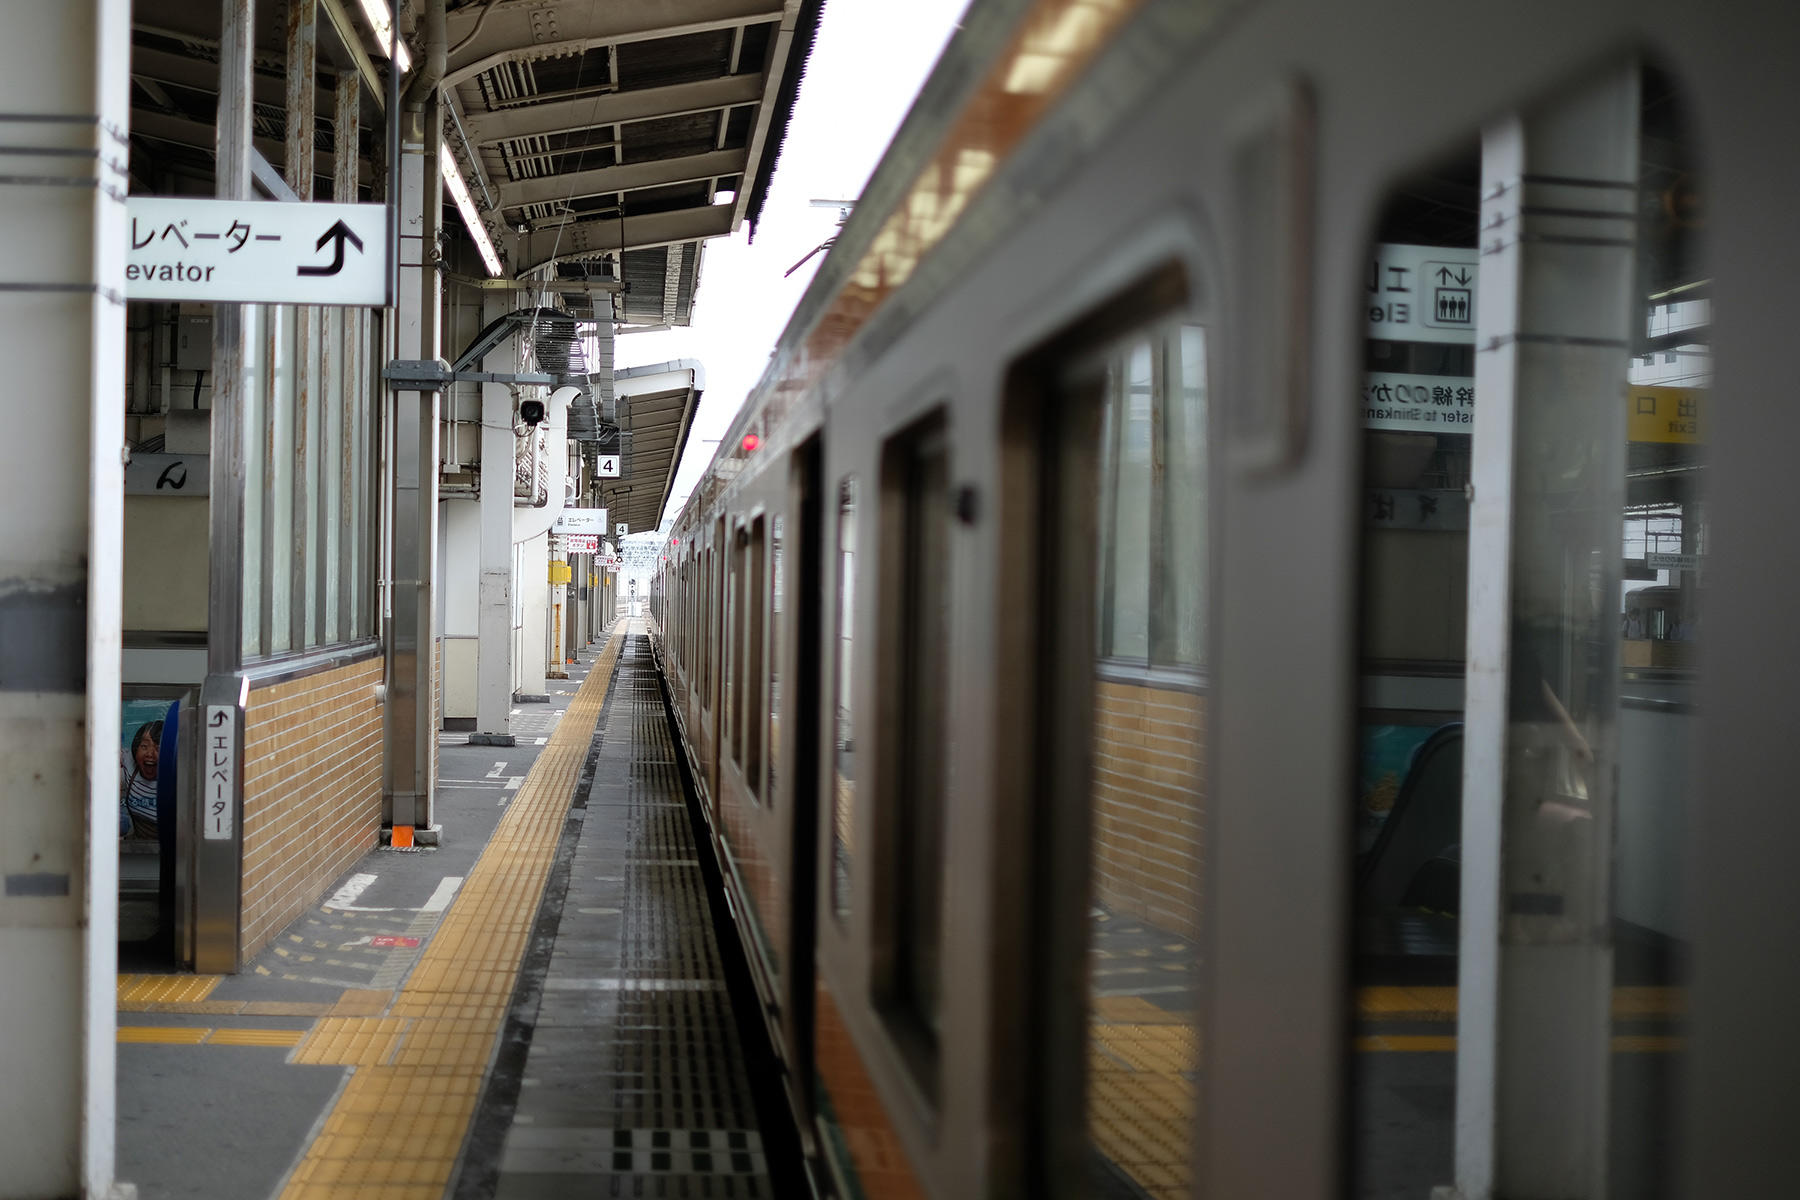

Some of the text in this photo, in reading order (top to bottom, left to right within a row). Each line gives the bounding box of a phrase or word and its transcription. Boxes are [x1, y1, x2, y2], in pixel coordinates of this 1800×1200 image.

[132, 217, 282, 254] レベーター
[126, 261, 215, 282] evator
[156, 461, 187, 490] ん
[603, 459, 614, 473] 4
[618, 525, 625, 533] 4
[212, 736, 228, 833] エレベーター
